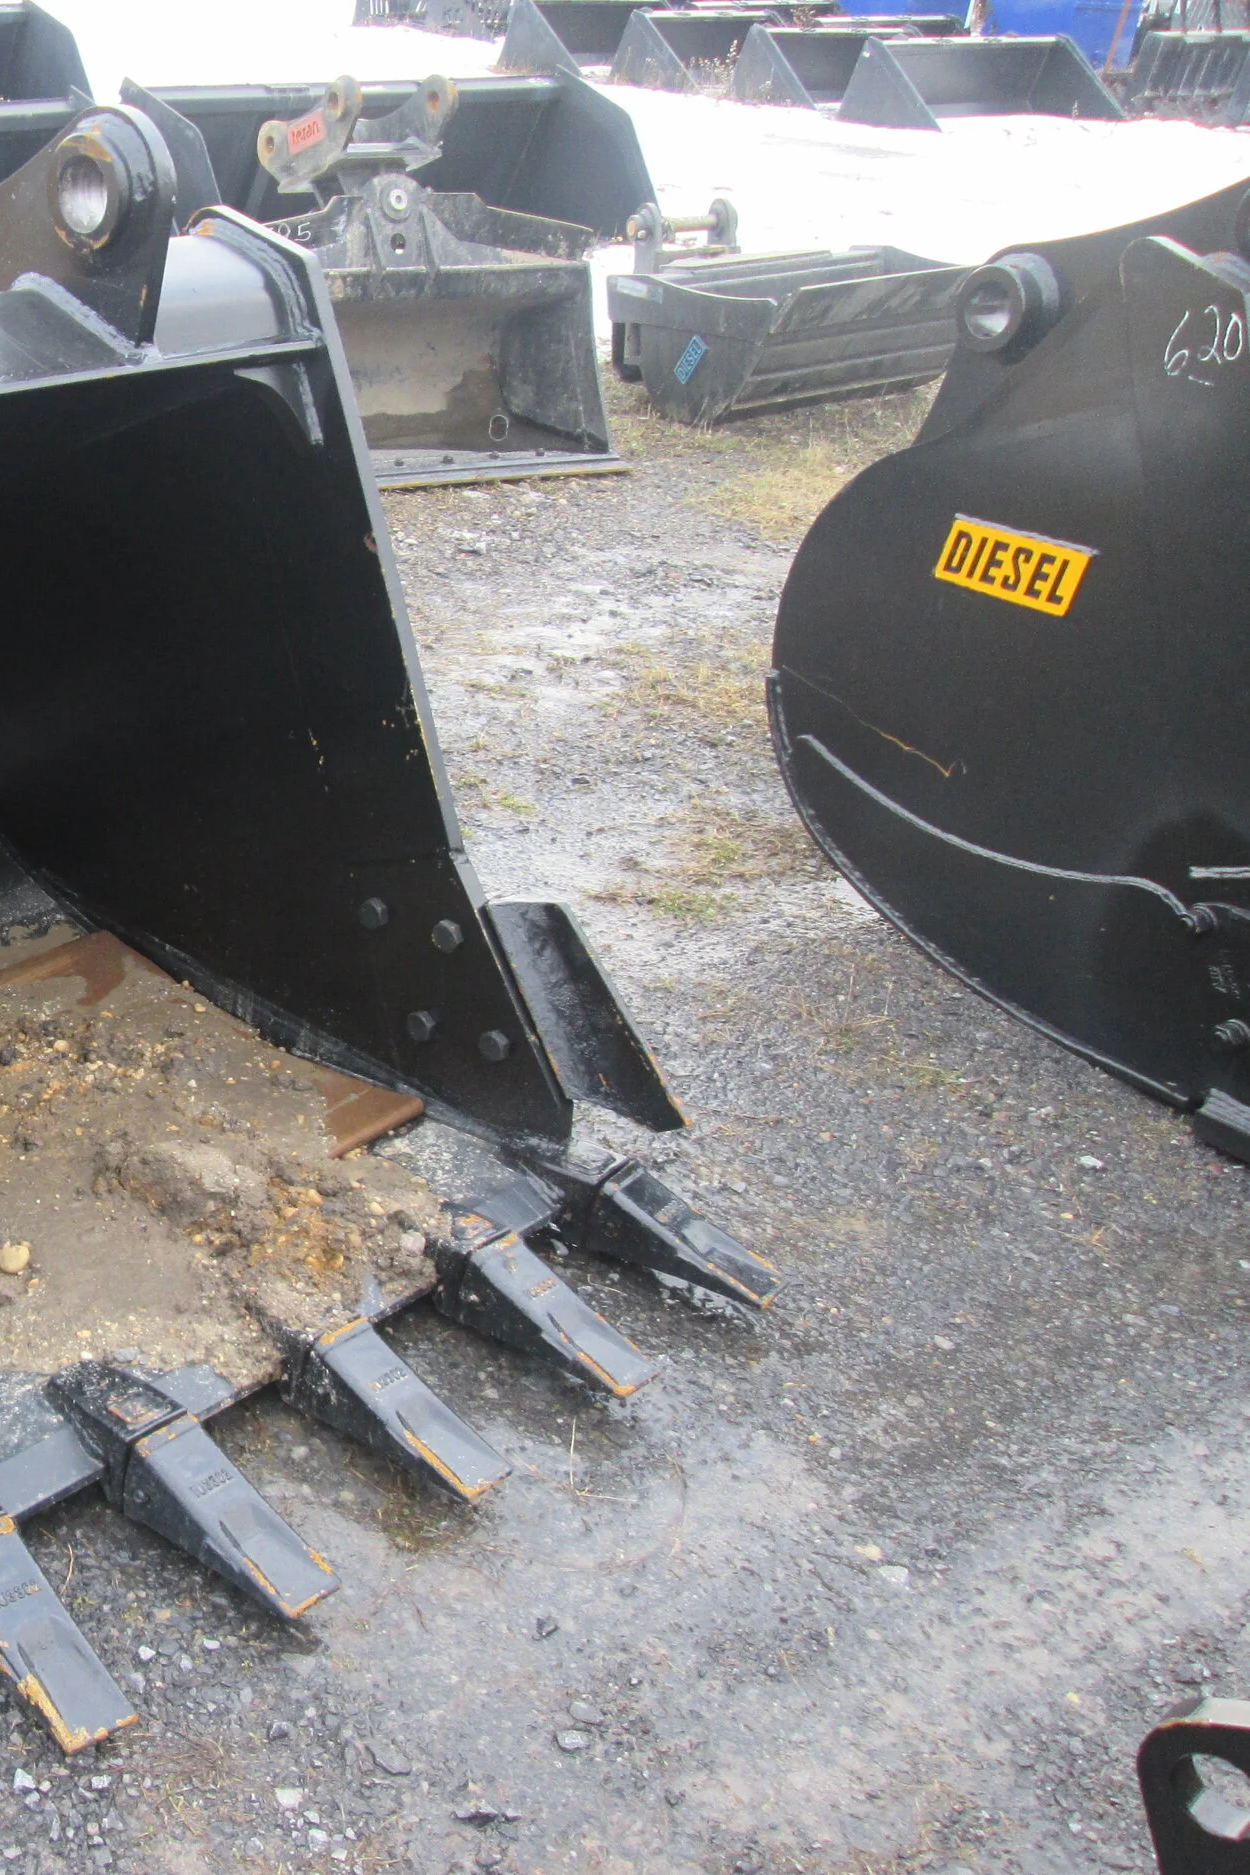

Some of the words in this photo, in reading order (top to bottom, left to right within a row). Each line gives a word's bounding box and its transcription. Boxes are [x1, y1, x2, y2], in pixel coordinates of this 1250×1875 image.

[676, 342, 703, 380] DIESEL
[1163, 305, 1243, 376] 620
[942, 529, 1071, 606] DIESEL
